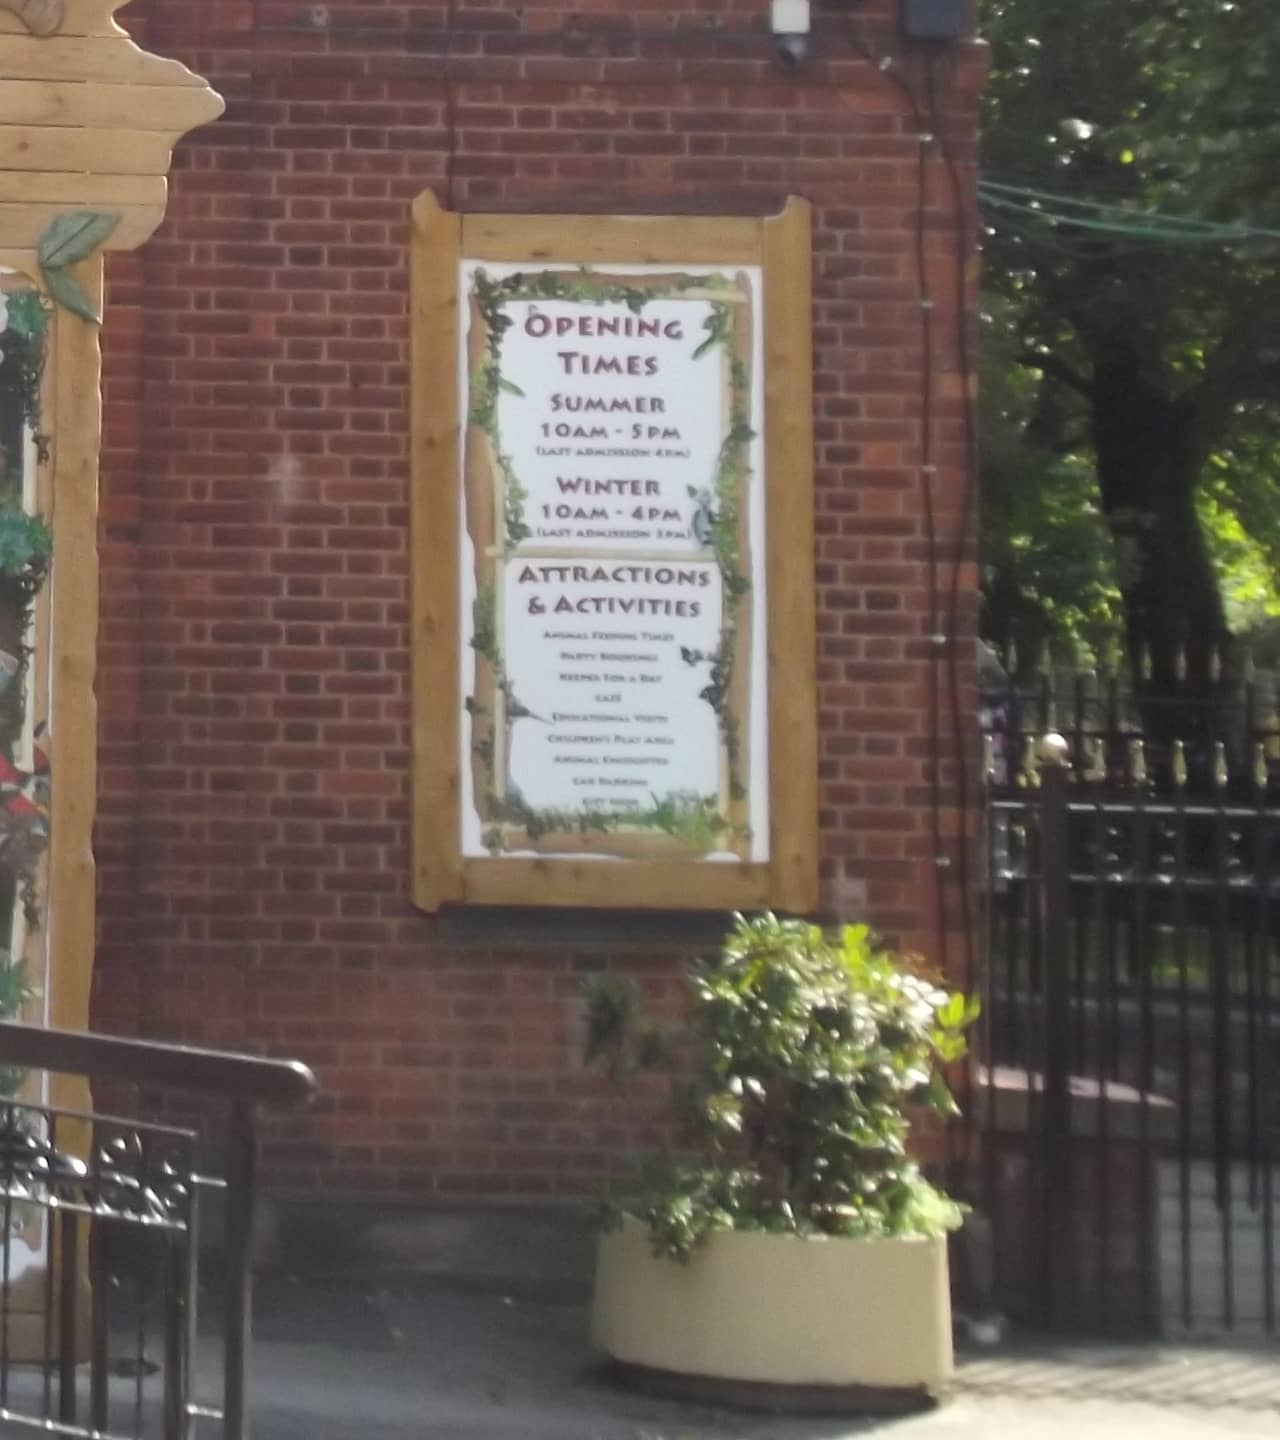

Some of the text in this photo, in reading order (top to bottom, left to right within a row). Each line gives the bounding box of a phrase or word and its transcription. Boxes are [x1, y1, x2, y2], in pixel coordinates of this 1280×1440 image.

[525, 313, 683, 340] OPENING
[557, 351, 658, 376] TIMES
[550, 393, 666, 414] SUMMER
[556, 476, 661, 496] WINTER
[518, 565, 710, 587] ATTRACTIONS
[528, 595, 702, 618] & ACTIVITIES
